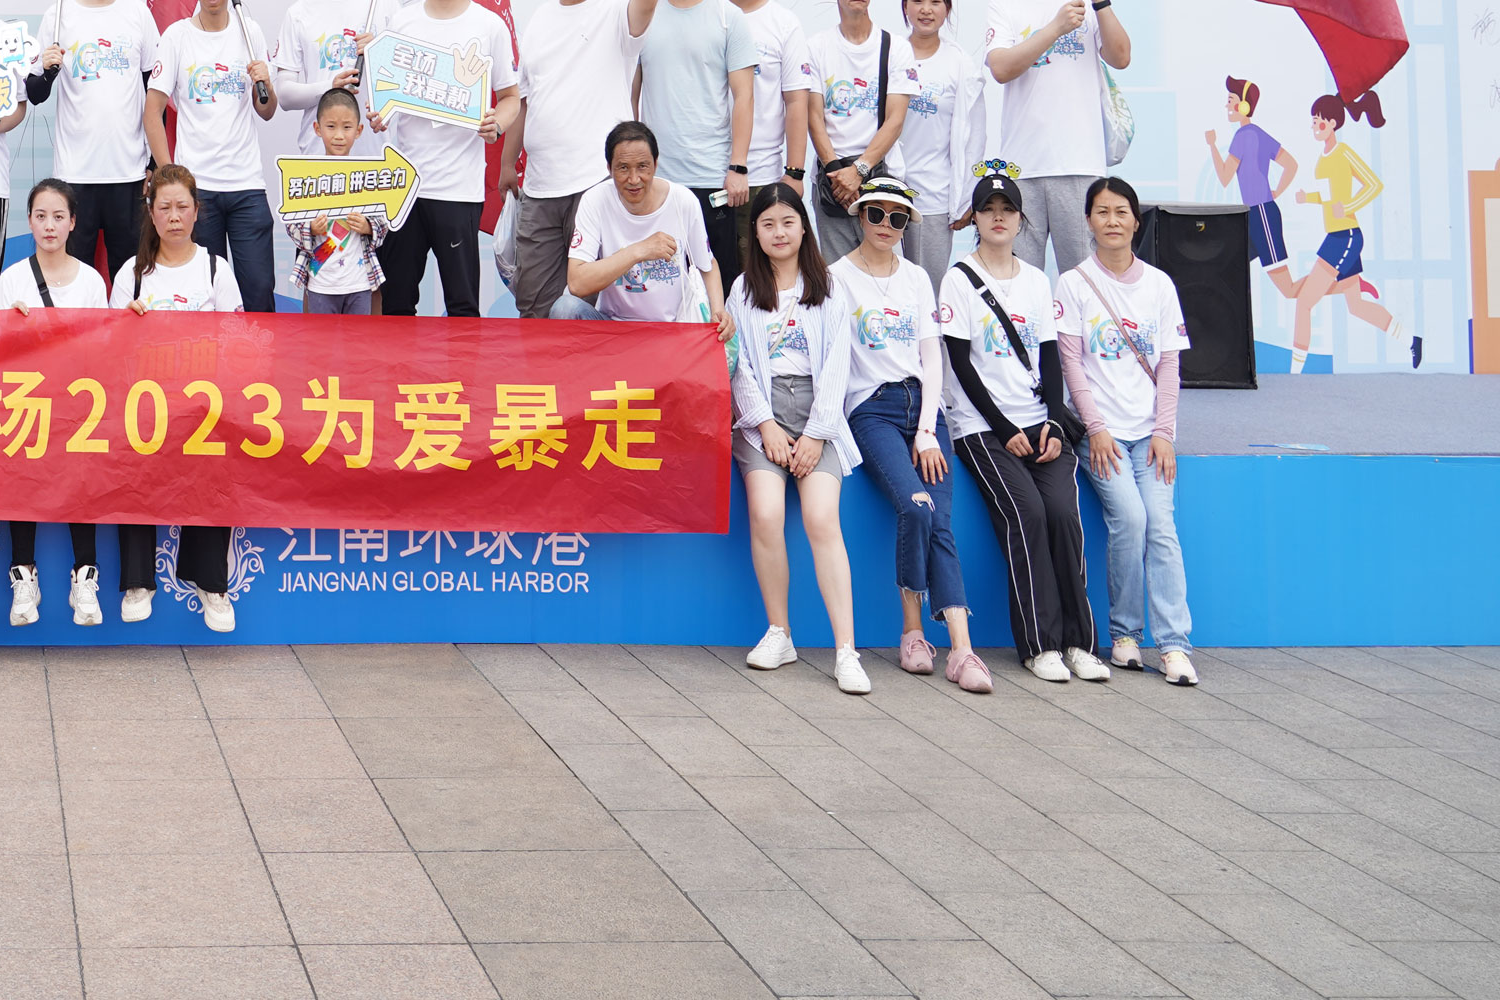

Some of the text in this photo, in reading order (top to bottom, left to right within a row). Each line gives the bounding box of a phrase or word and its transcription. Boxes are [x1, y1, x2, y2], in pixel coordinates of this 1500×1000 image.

[391, 43, 438, 76] 全场
[403, 71, 471, 113] 我最靓
[289, 167, 407, 200] 努力向前 拼尽全力
[992, 179, 1004, 189] R
[278, 571, 590, 594] JIANGNAN GLOBAL HARBOR
